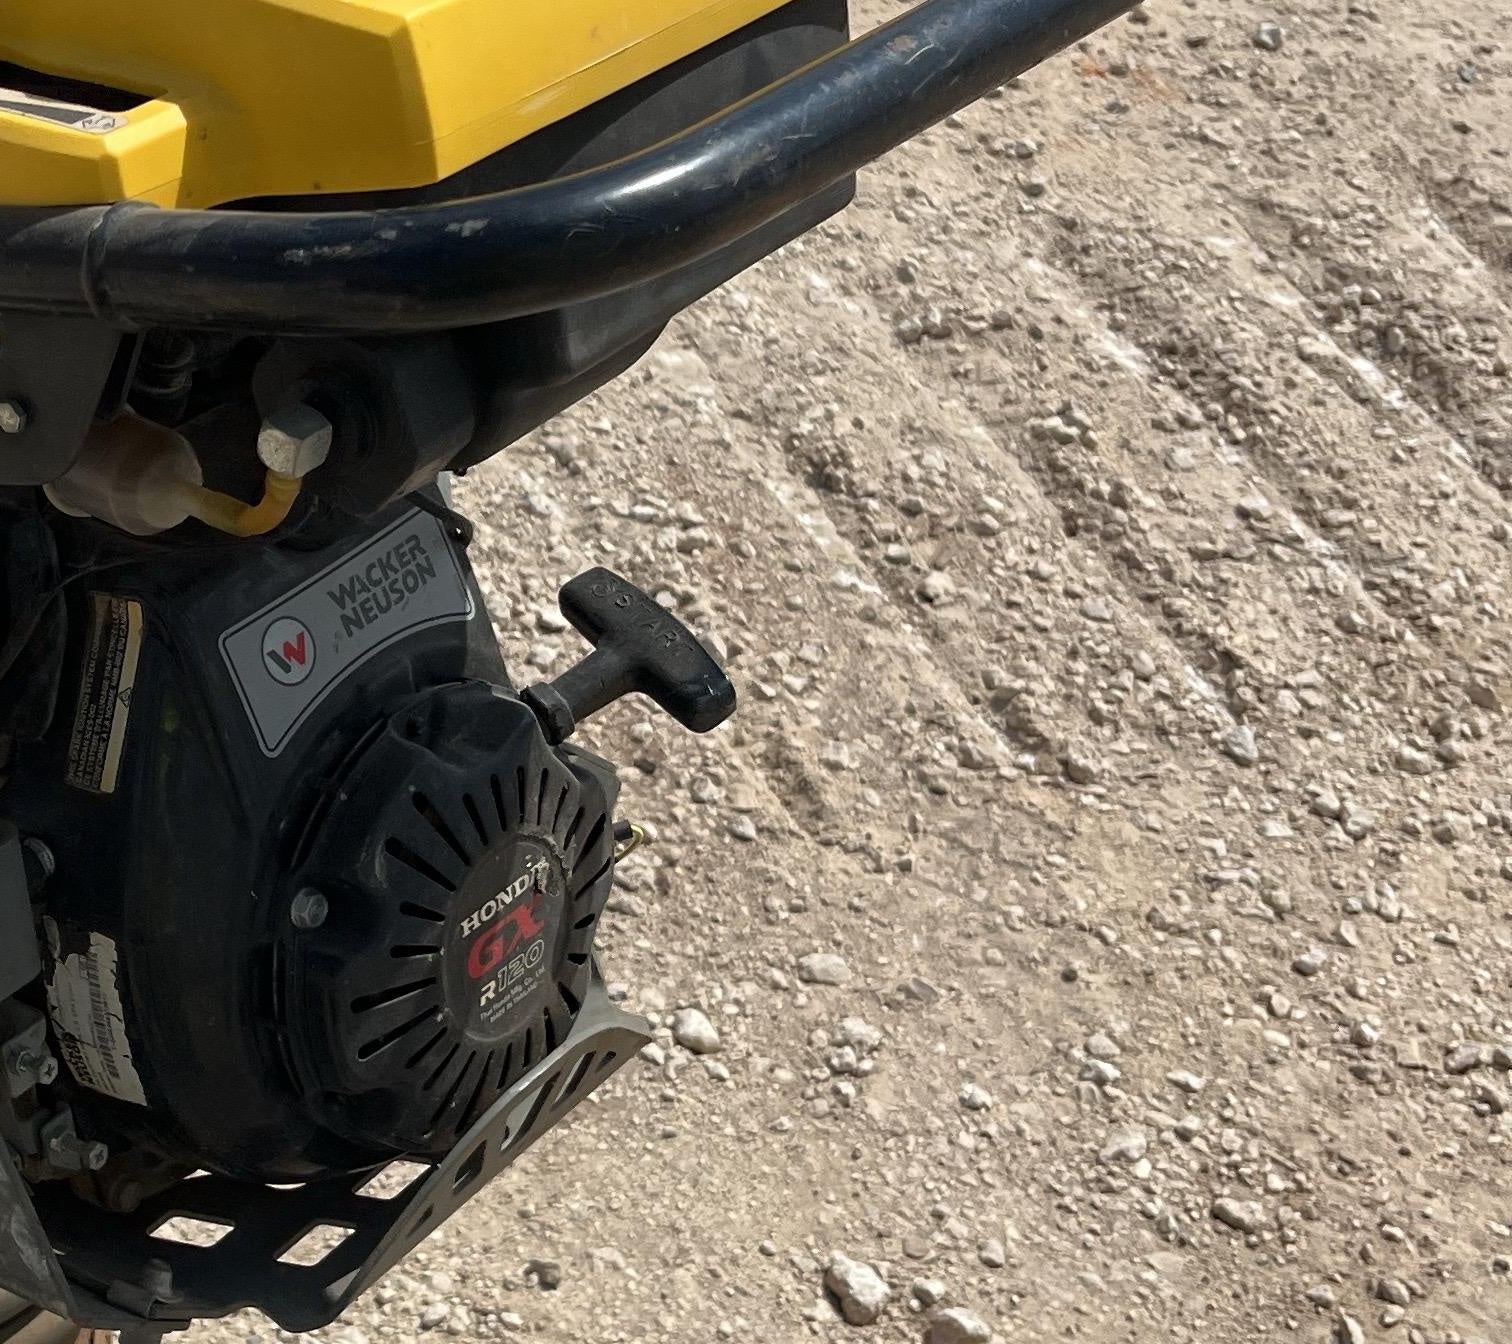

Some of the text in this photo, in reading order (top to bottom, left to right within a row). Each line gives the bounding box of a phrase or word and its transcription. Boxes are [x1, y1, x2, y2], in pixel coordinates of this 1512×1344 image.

[326, 534, 428, 611] WACKER
[339, 555, 437, 638] NEUSON
[468, 894, 547, 979] GX
